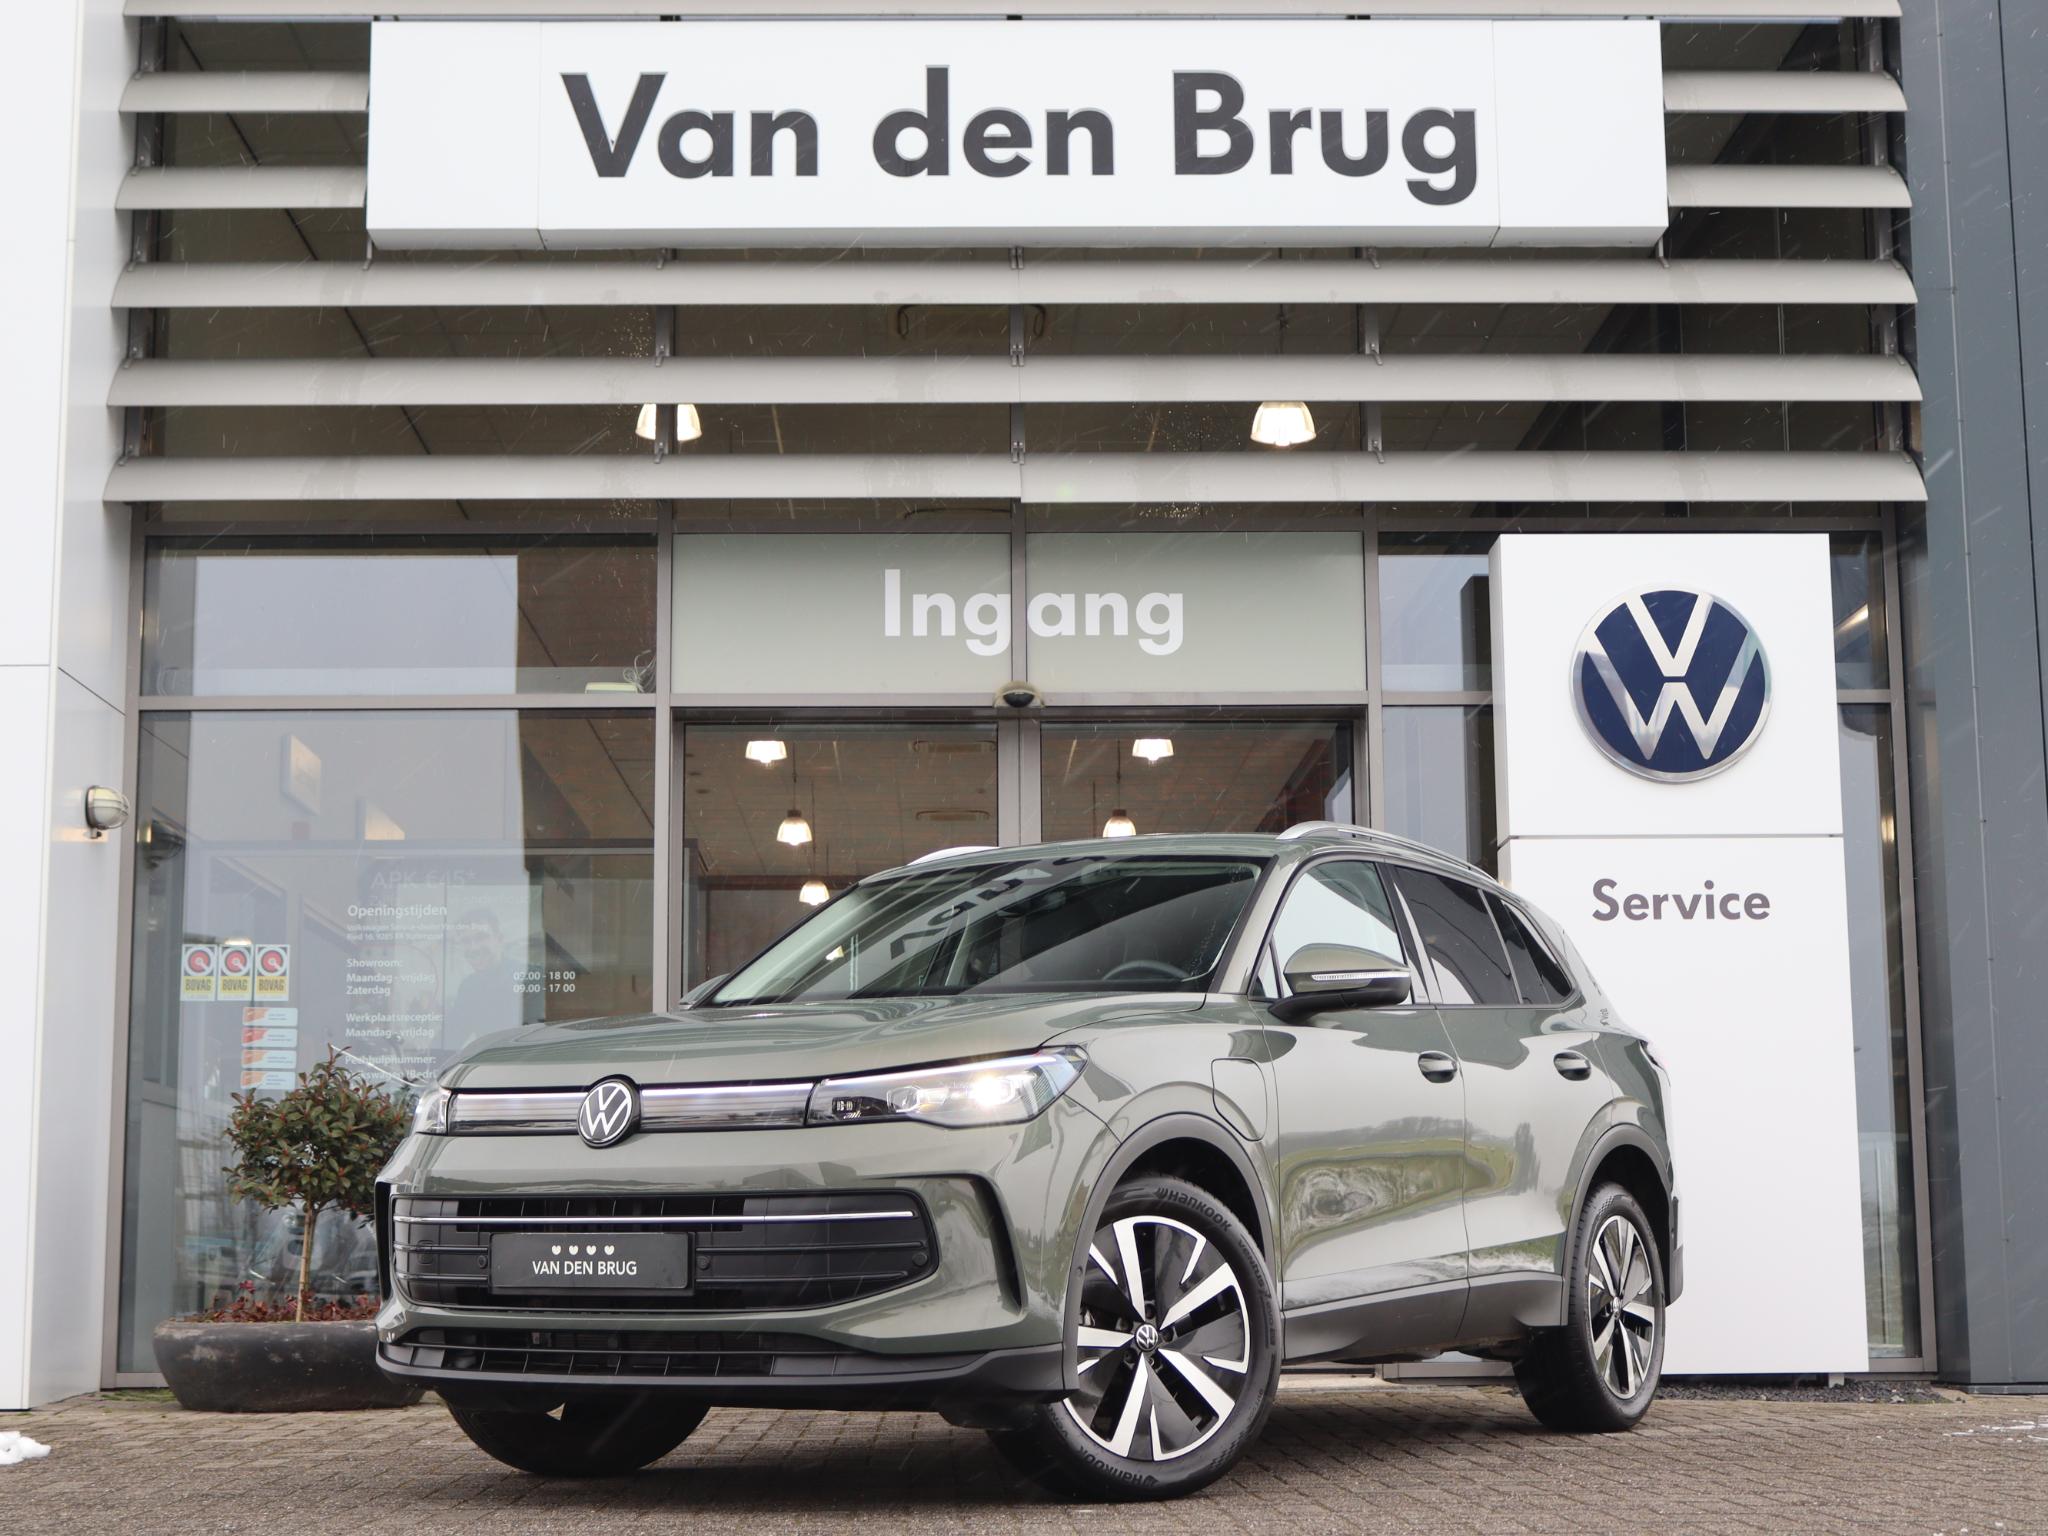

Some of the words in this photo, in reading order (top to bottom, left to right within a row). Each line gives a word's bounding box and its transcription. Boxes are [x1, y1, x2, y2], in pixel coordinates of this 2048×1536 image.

[560, 71, 819, 179] Van
[872, 64, 1115, 178] den
[1172, 69, 1478, 206] Brug
[884, 568, 1184, 657] Ingang
[1592, 878, 1771, 922] Service
[347, 903, 448, 919] Openingstijden
[346, 958, 404, 968] Showroom:
[185, 978, 212, 991] BOVAG
[222, 978, 248, 991] BOVAG
[258, 978, 285, 991] BOVAG
[346, 973, 392, 984] Maandag
[400, 973, 436, 985] vrijdag
[345, 985, 391, 997] Zaterdag
[513, 983, 541, 993] 09.00
[345, 1012, 443, 1024] Werkplaatsreceptie:
[345, 1027, 392, 1039] Maandag
[400, 1027, 435, 1039] vrijdag
[532, 1260, 560, 1275] VAN
[564, 1260, 593, 1275] DEN
[597, 1260, 638, 1276] BRUG
